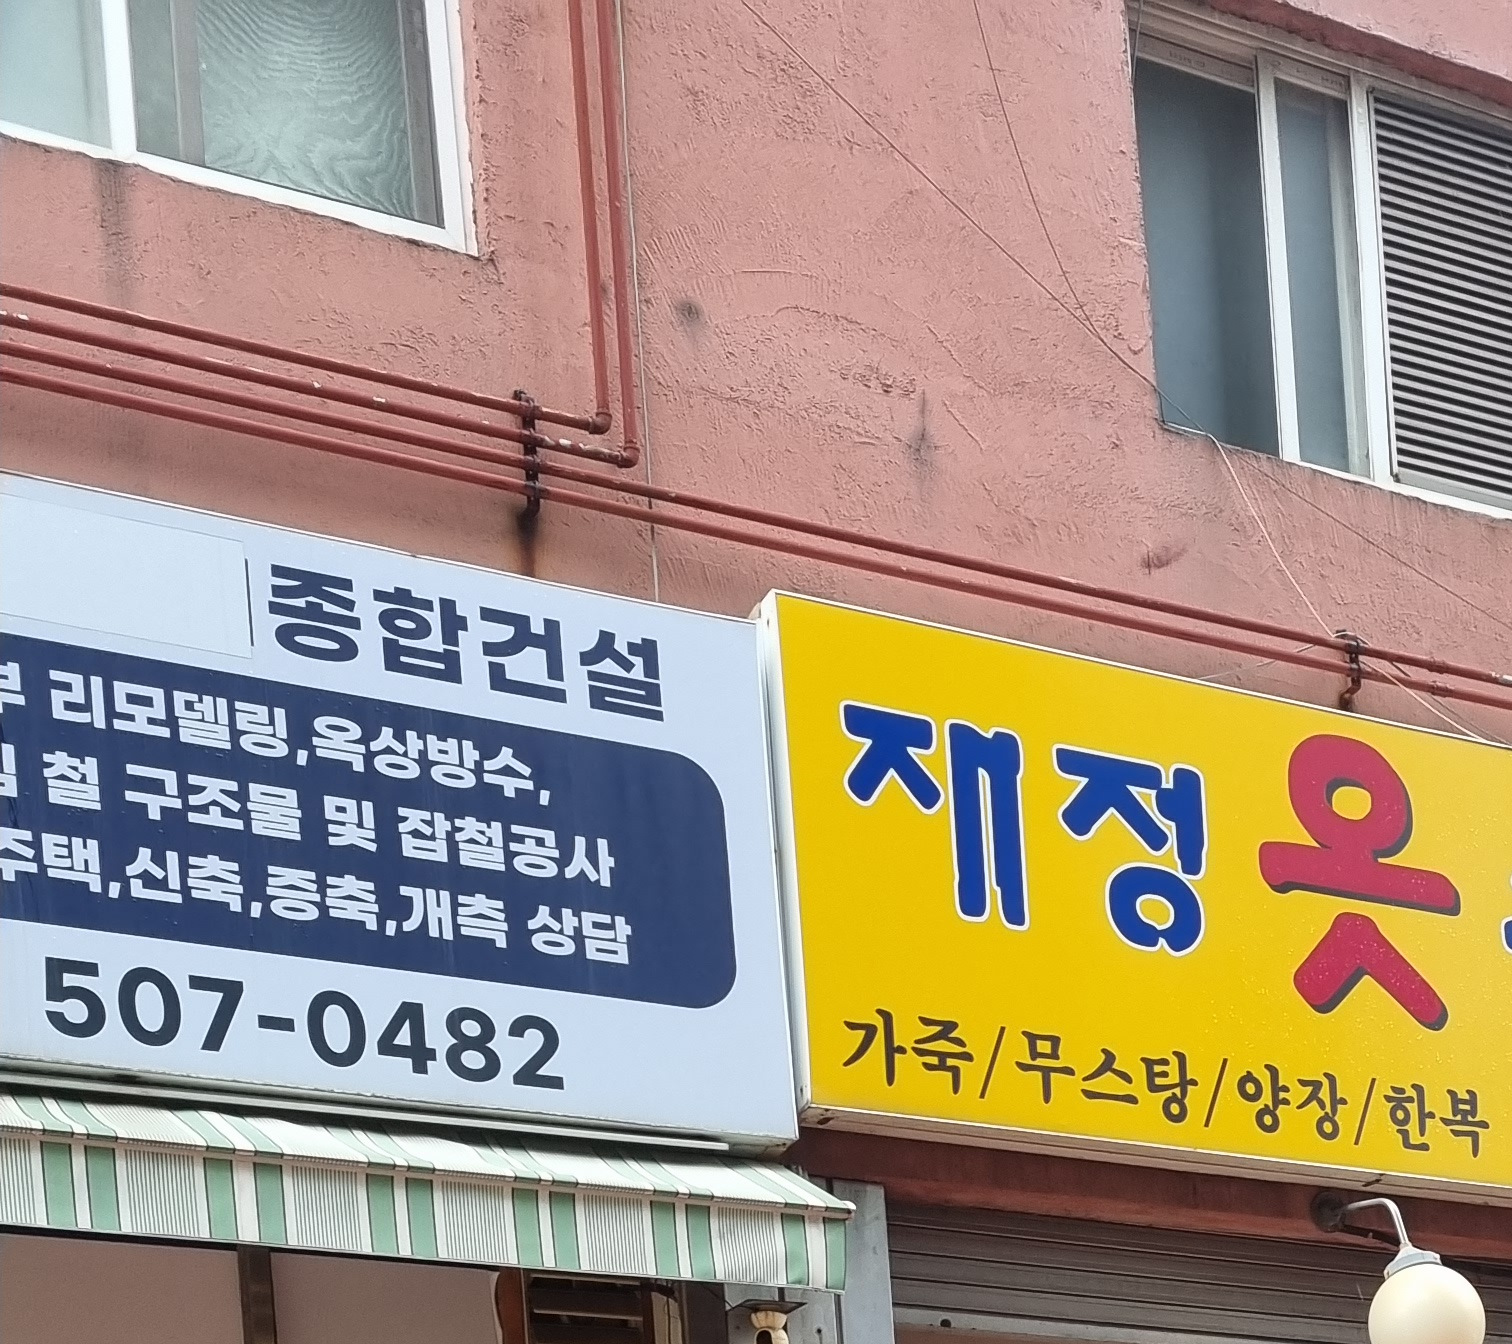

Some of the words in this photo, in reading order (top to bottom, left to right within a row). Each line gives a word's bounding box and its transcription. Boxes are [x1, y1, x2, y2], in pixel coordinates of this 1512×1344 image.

[266, 563, 664, 722] 종합건설
[42, 750, 102, 810] 철
[124, 763, 302, 841] 구조물
[323, 795, 378, 852] 및
[397, 806, 615, 888] 잡철공사
[840, 700, 1207, 956] 재정
[1258, 733, 1462, 1032] 옷
[527, 904, 632, 965] 상담
[43, 956, 566, 1092] 507-0482
